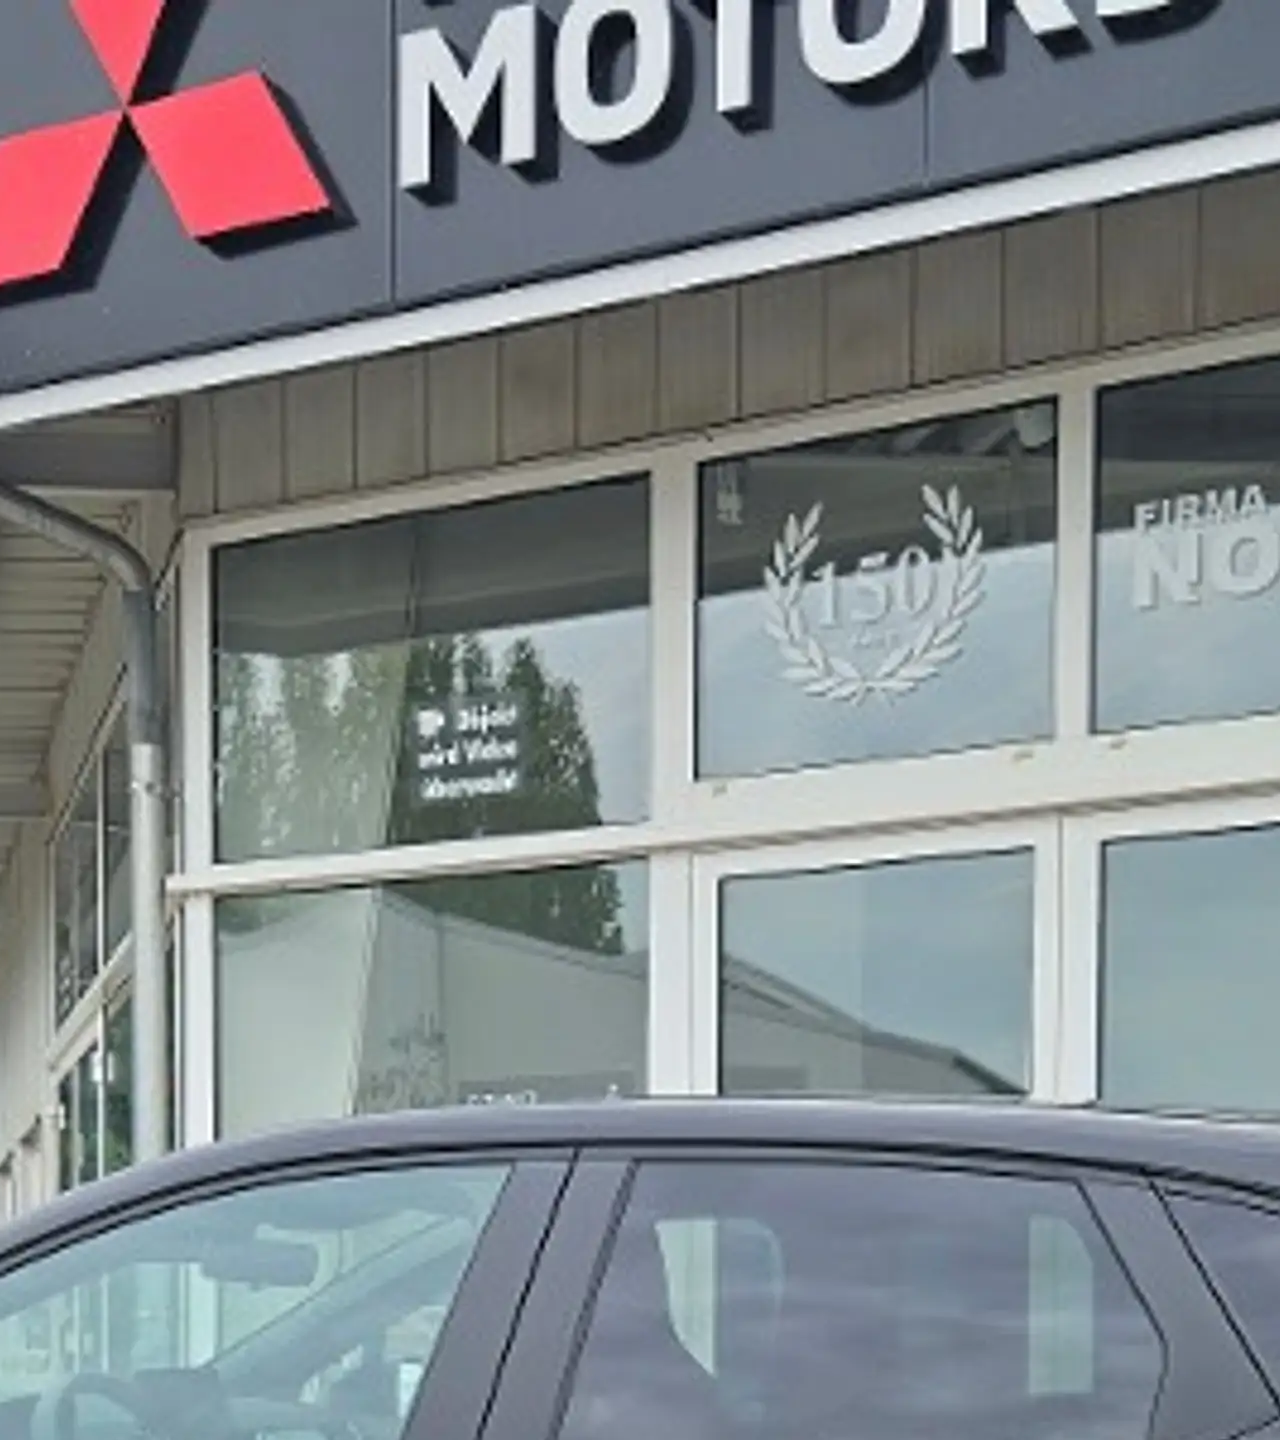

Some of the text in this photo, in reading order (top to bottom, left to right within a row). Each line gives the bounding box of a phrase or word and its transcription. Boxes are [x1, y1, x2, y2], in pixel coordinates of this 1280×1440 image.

[399, 0, 1176, 190] MOTO
[1134, 485, 1267, 535] FIRMA
[811, 547, 933, 629] 150
